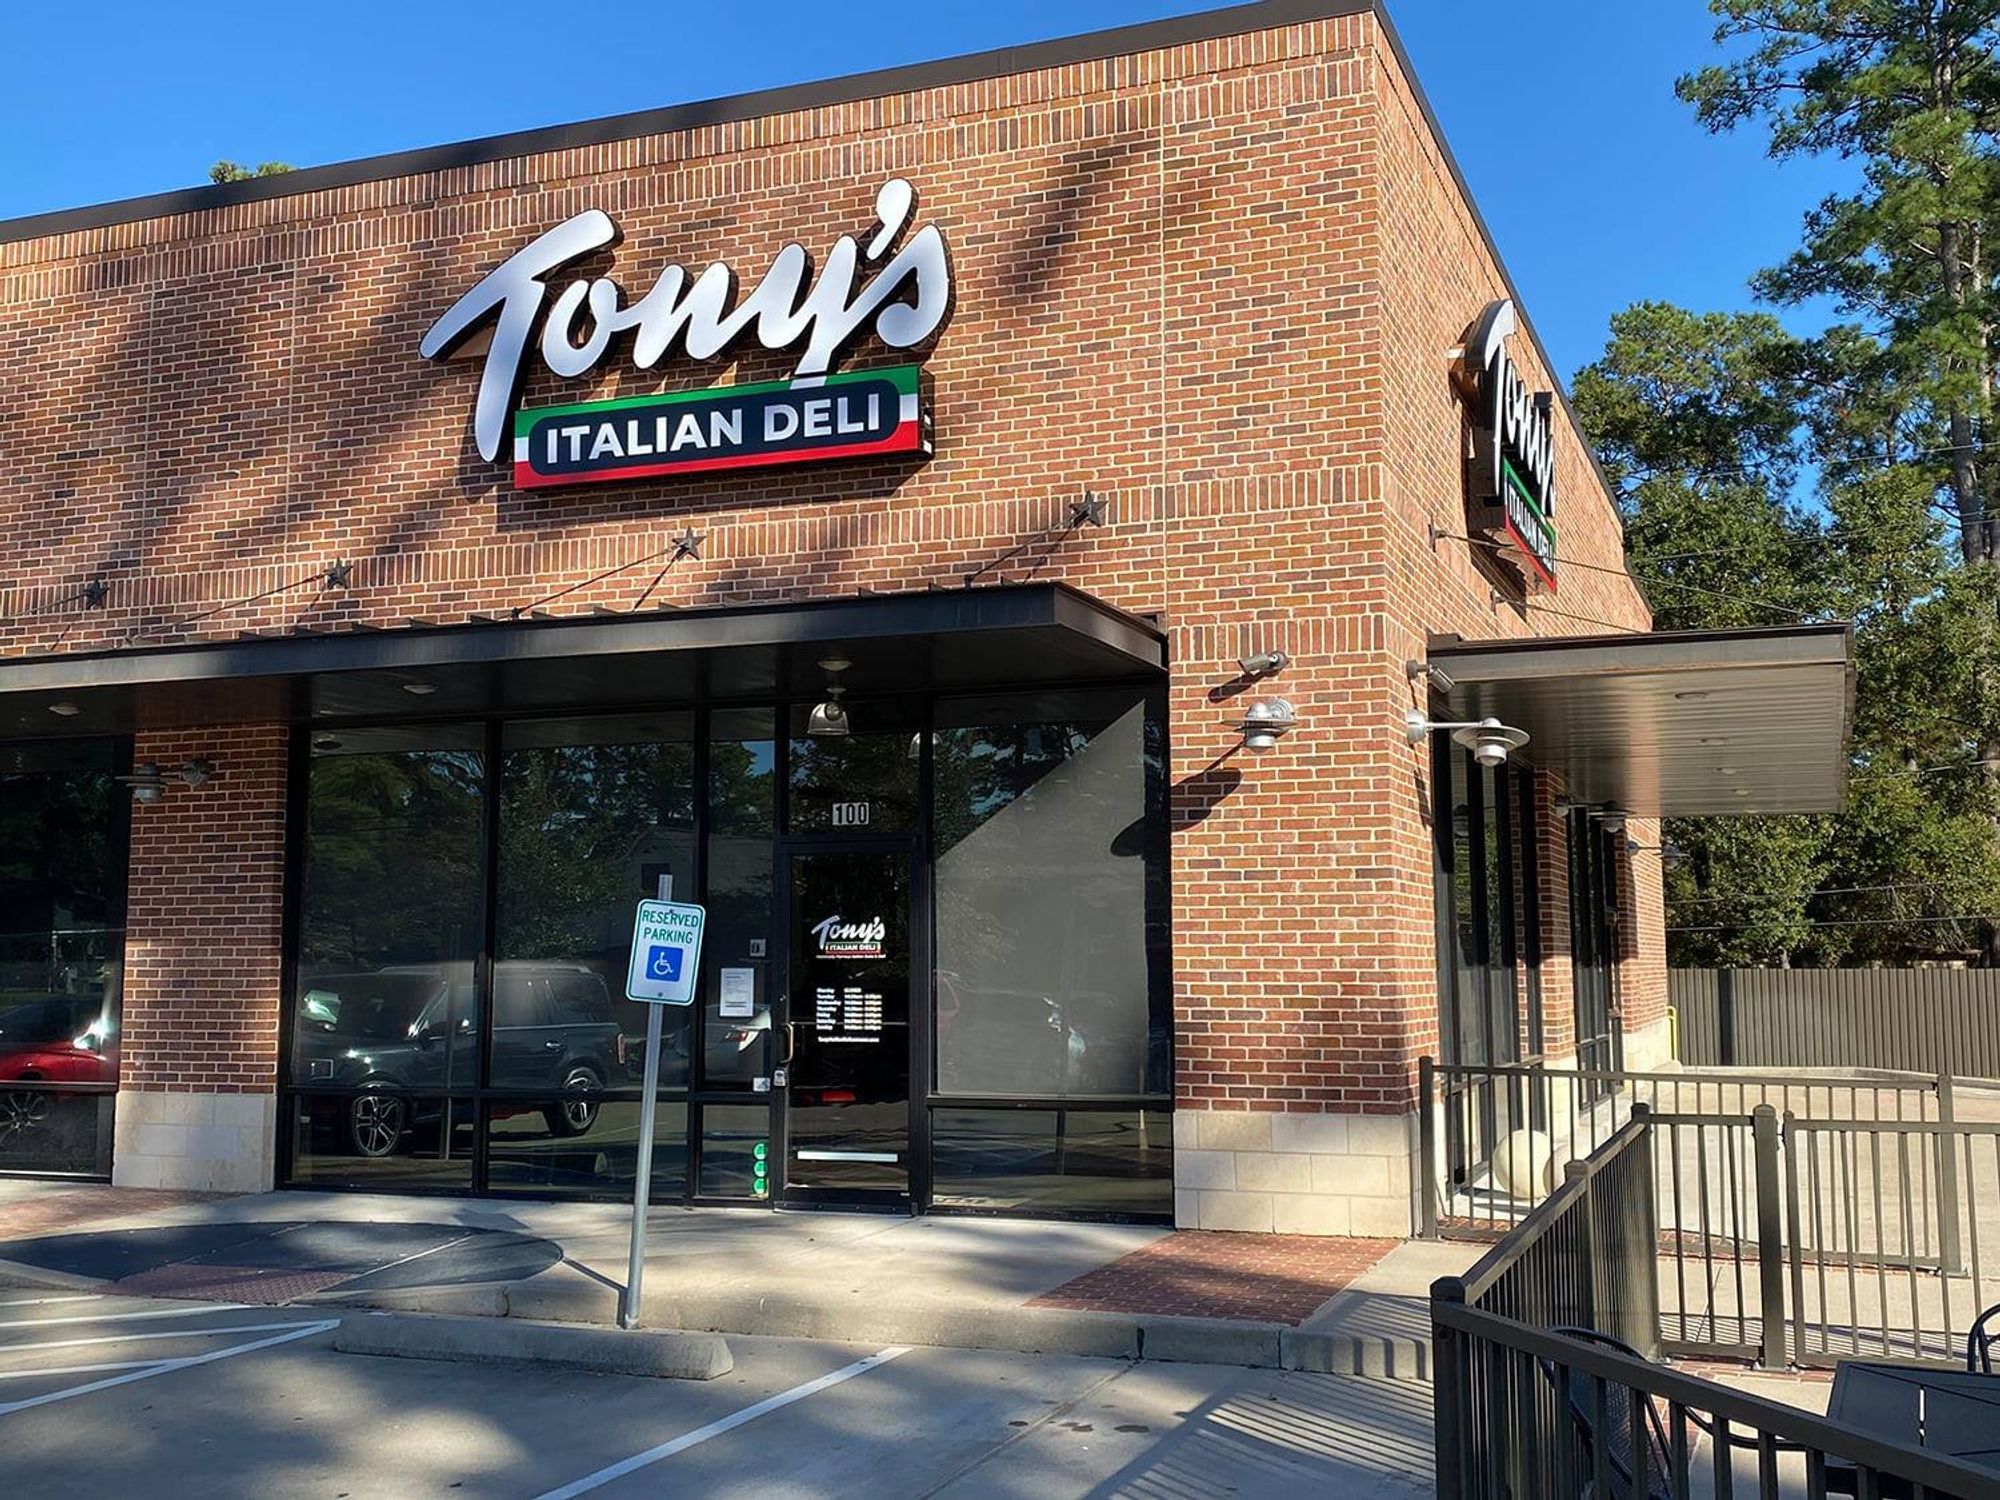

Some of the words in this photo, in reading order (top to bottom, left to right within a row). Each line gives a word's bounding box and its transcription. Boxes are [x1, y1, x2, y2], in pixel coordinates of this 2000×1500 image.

[419, 178, 950, 462] Tony's
[545, 408, 743, 464] ITALIAN
[762, 393, 880, 443] DELI
[835, 803, 867, 824] 100
[641, 909, 699, 928] RESERVED
[811, 915, 885, 950] Tony's
[643, 927, 693, 944] PARKING
